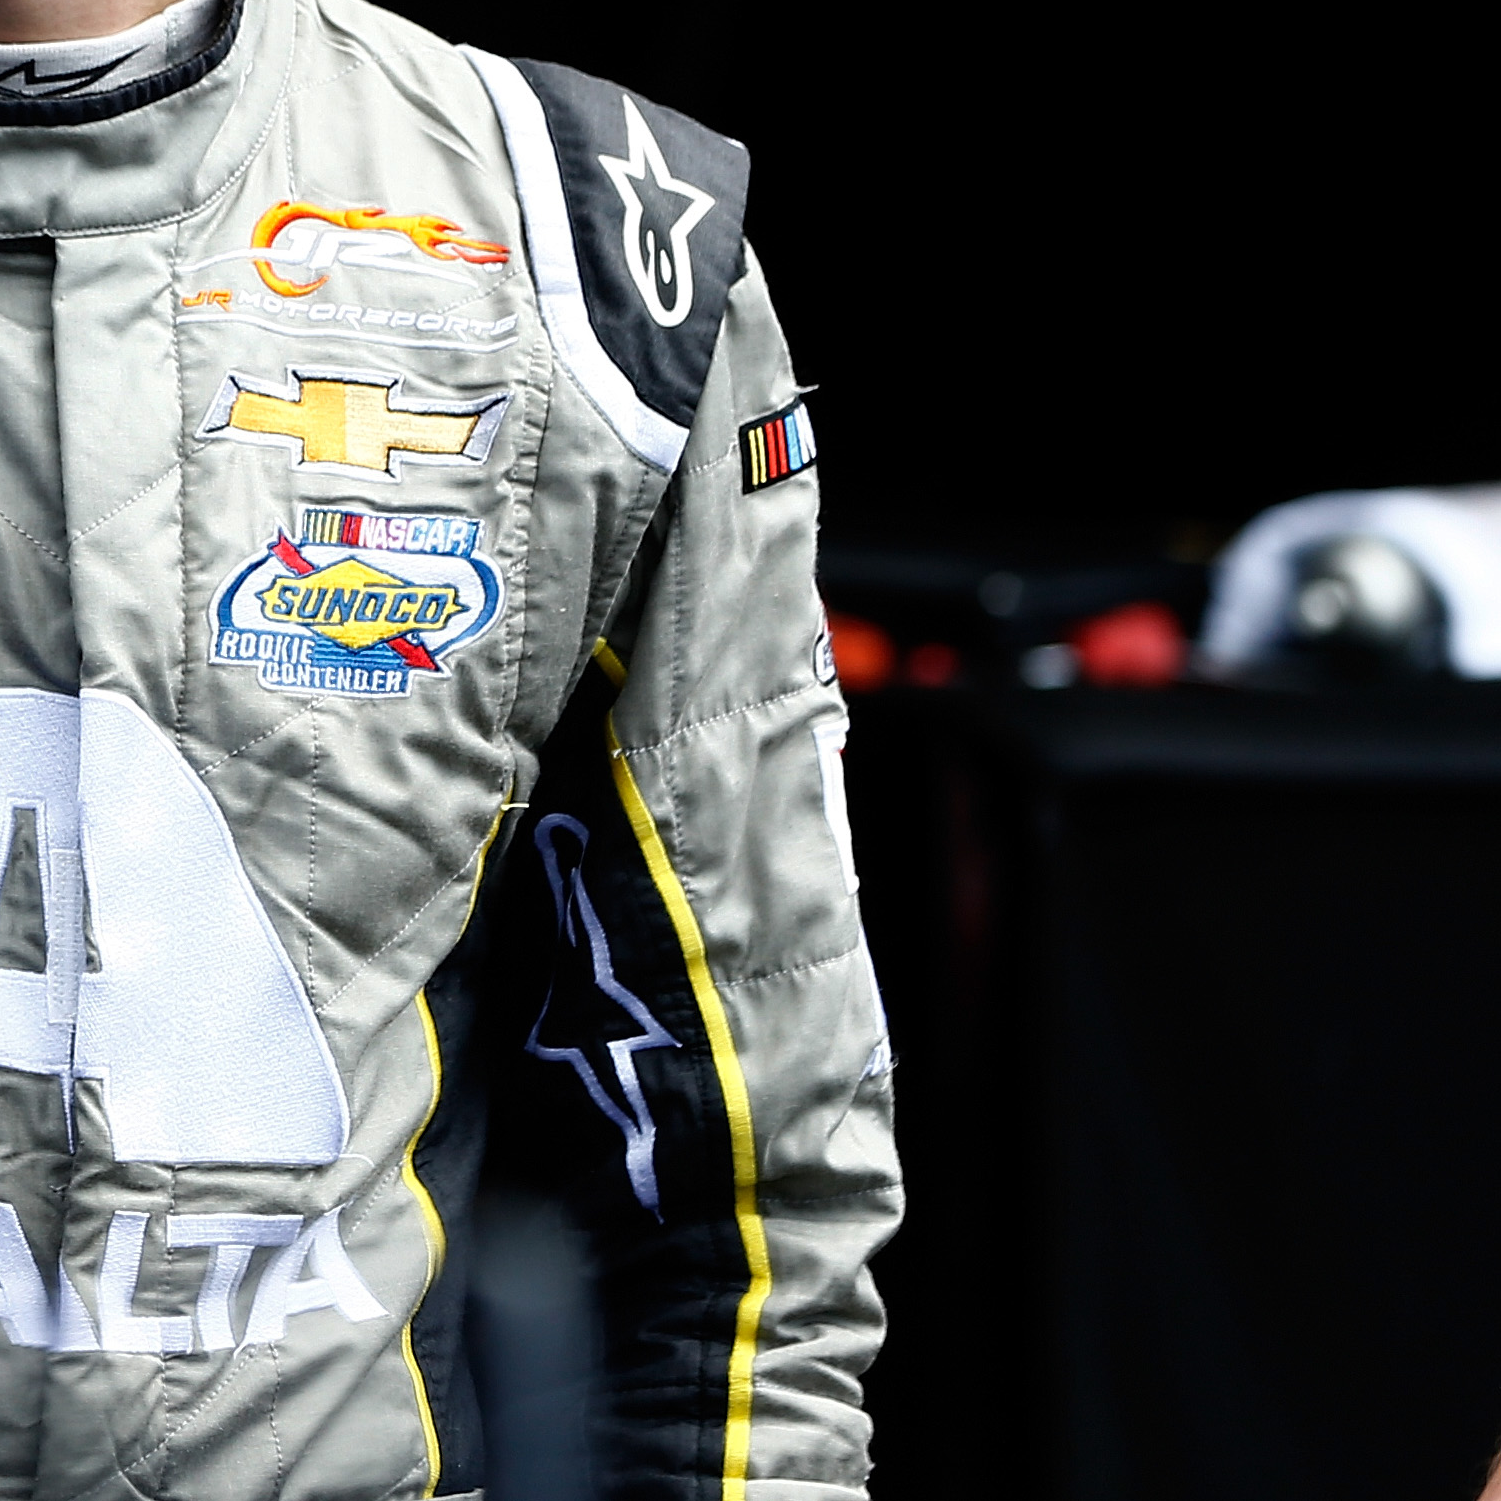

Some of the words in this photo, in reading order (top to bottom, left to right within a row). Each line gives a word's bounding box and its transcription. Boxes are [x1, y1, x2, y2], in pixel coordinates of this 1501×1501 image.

[182, 289, 232, 312] JR
[236, 290, 519, 341] MOTORSPORTS
[357, 515, 470, 554] NASCAR
[271, 585, 447, 623] SUNOCO
[220, 630, 315, 665] ROOKIE
[265, 662, 403, 692] CONTENDER
